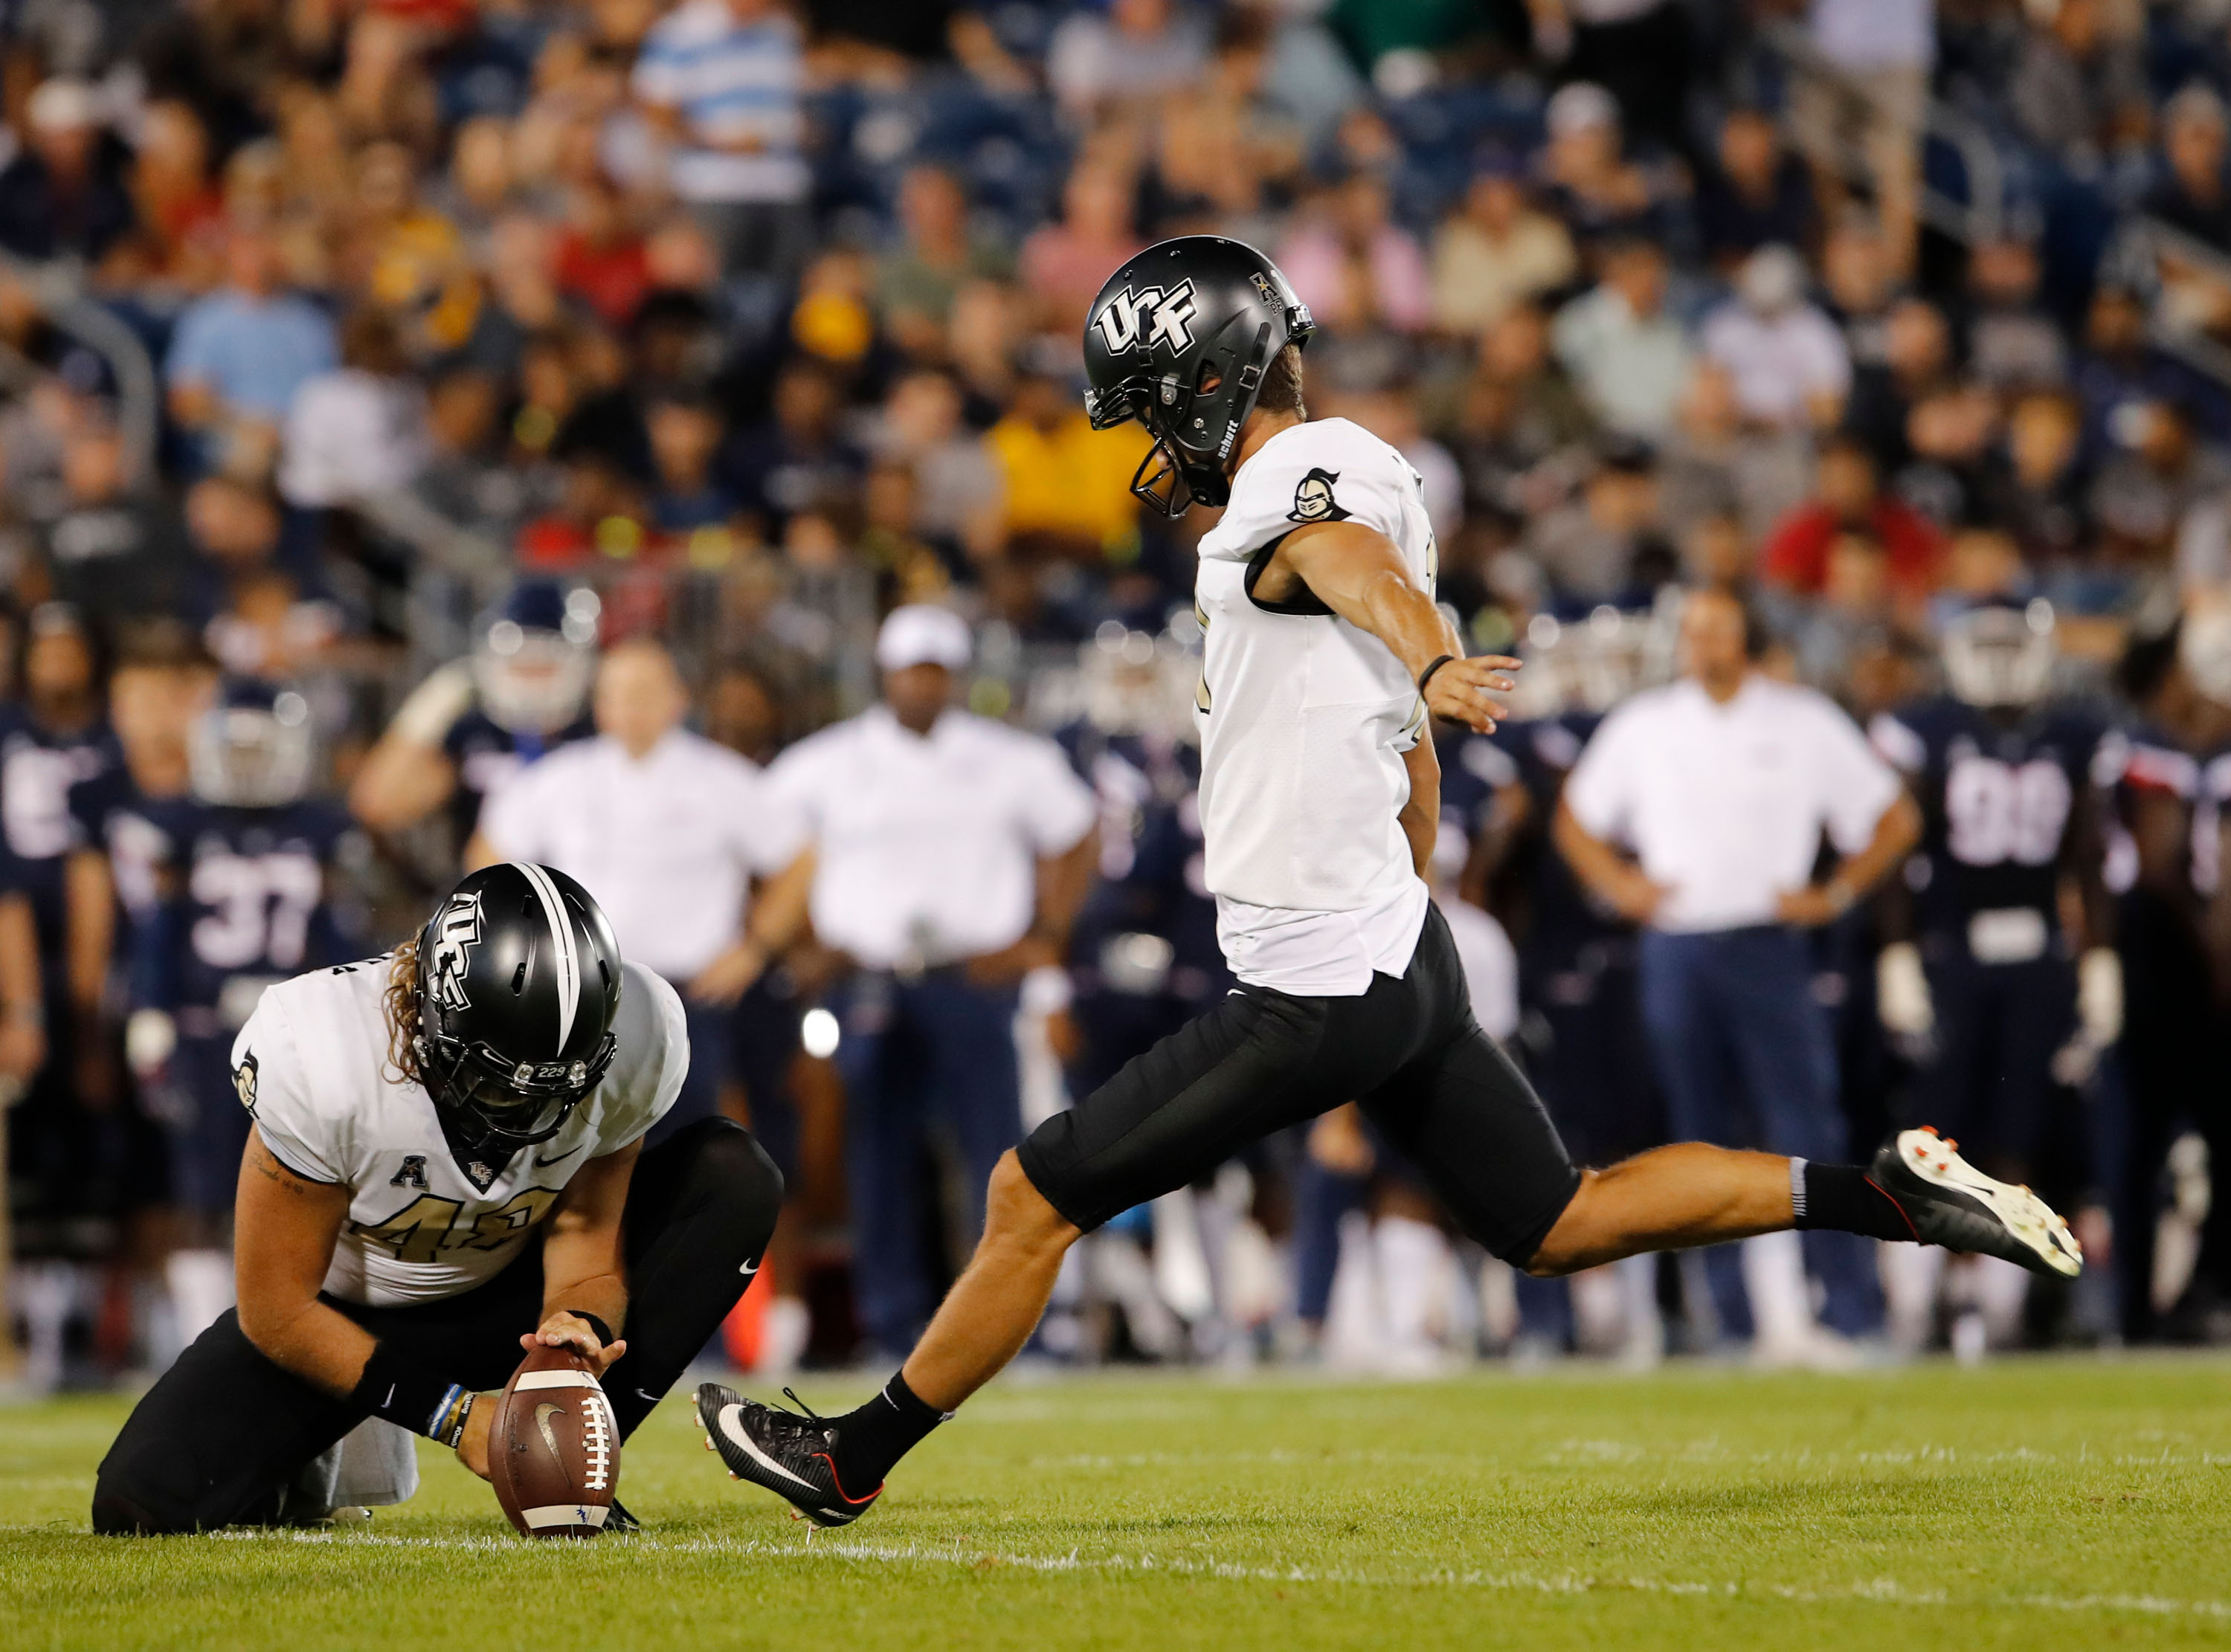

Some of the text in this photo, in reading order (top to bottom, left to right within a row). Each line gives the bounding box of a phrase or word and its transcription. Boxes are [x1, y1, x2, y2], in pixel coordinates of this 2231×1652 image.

[1090, 277, 1199, 358] UCF
[1217, 419, 1240, 459] schutt
[428, 890, 482, 1012] UCF
[538, 1066, 566, 1078] 229
[390, 1155, 427, 1187] A
[468, 1161, 493, 1185] UCF
